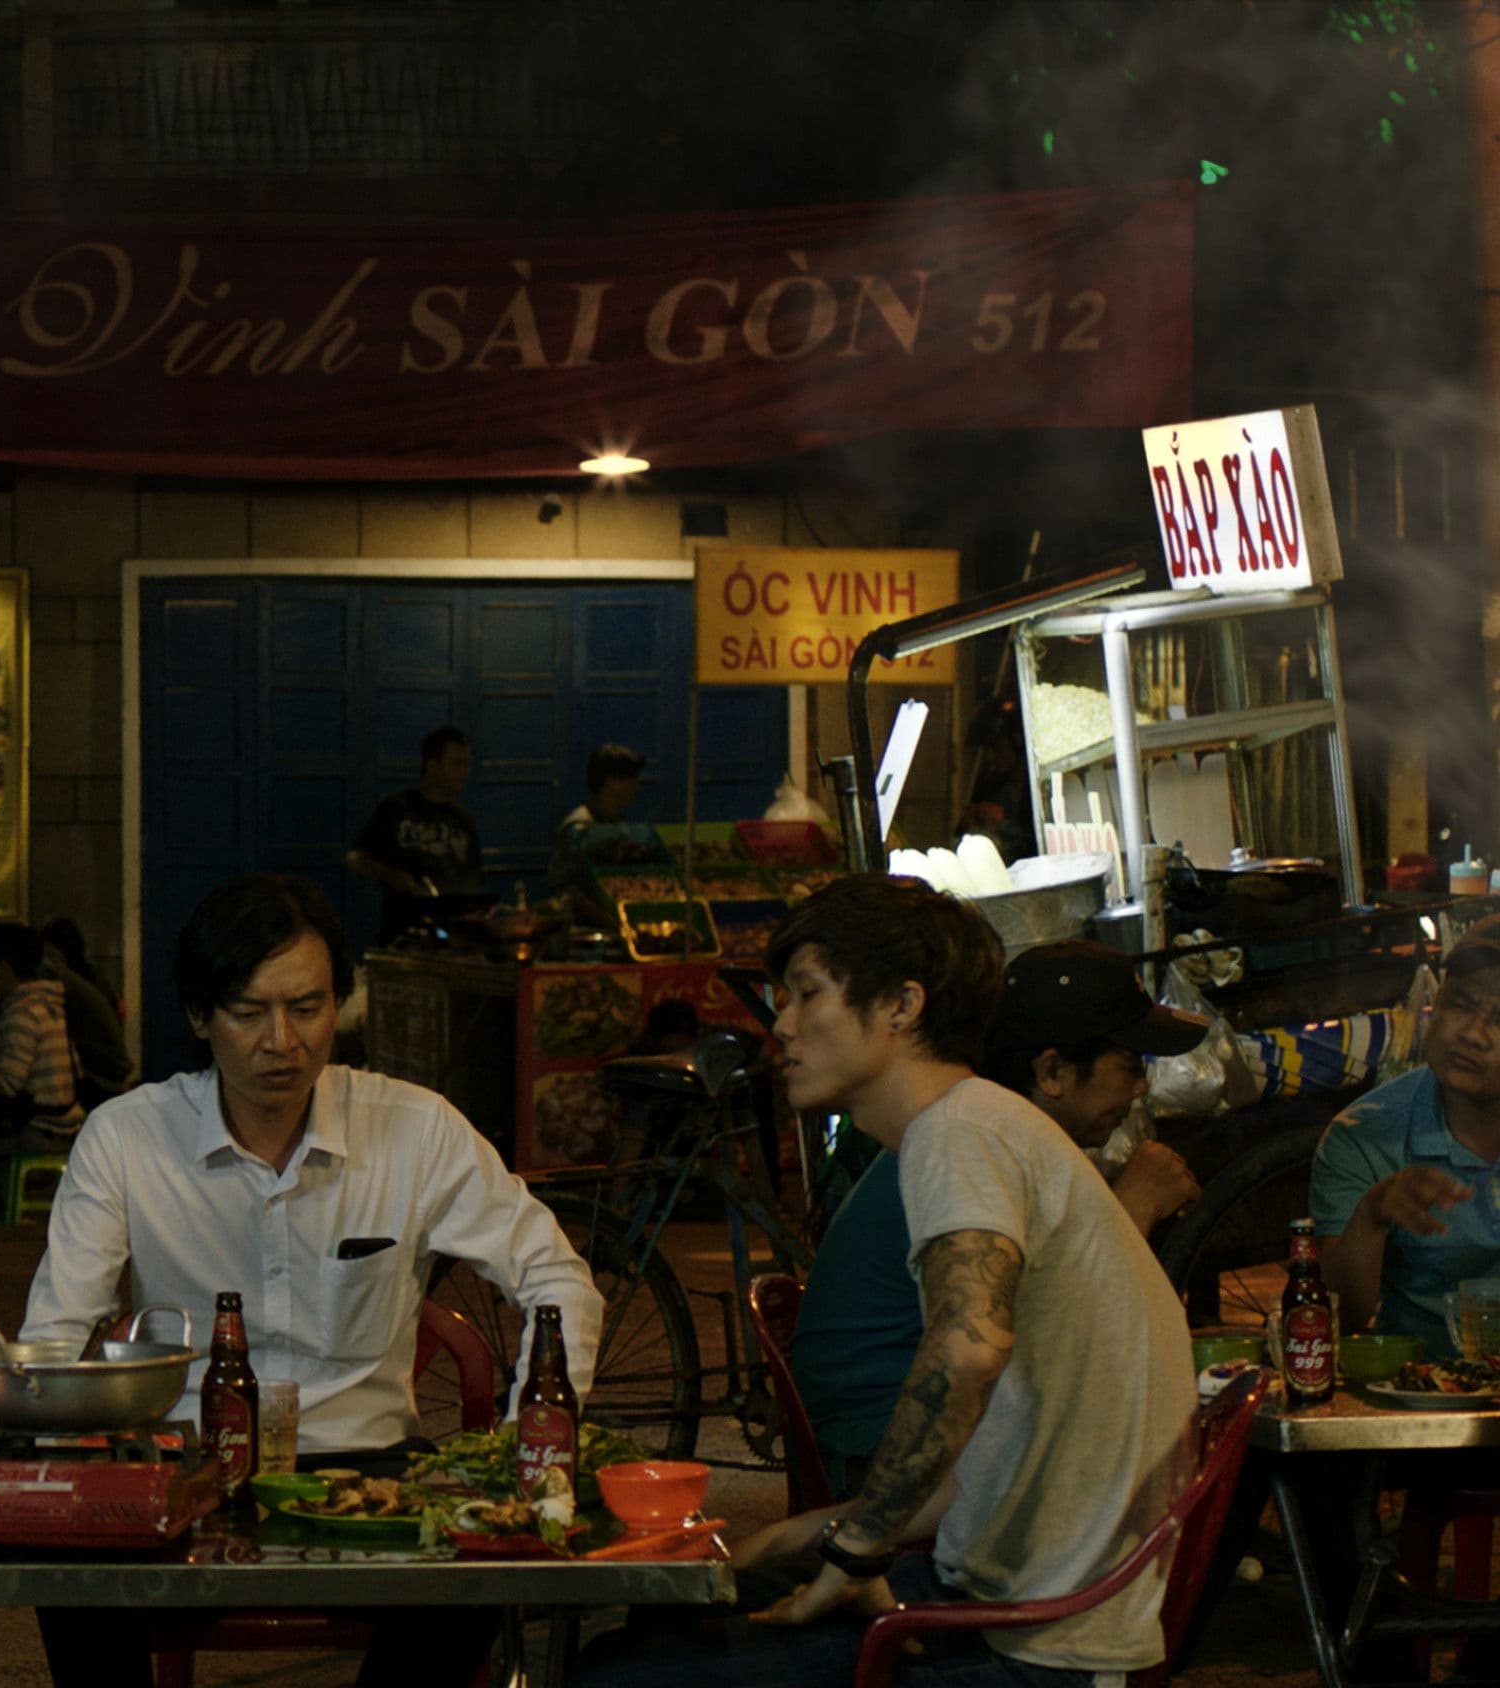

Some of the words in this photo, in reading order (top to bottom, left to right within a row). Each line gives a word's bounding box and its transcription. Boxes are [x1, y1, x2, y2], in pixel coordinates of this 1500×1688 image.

[0, 241, 380, 378] Vinh
[397, 259, 613, 376] SÀI
[644, 250, 949, 368] GÒN
[970, 290, 1107, 354] 512
[1222, 427, 1299, 573] XÀO
[722, 559, 791, 617] ỐC
[806, 570, 917, 616] VINH
[720, 629, 778, 671] SÀI
[1293, 1356, 1325, 1369] 999
